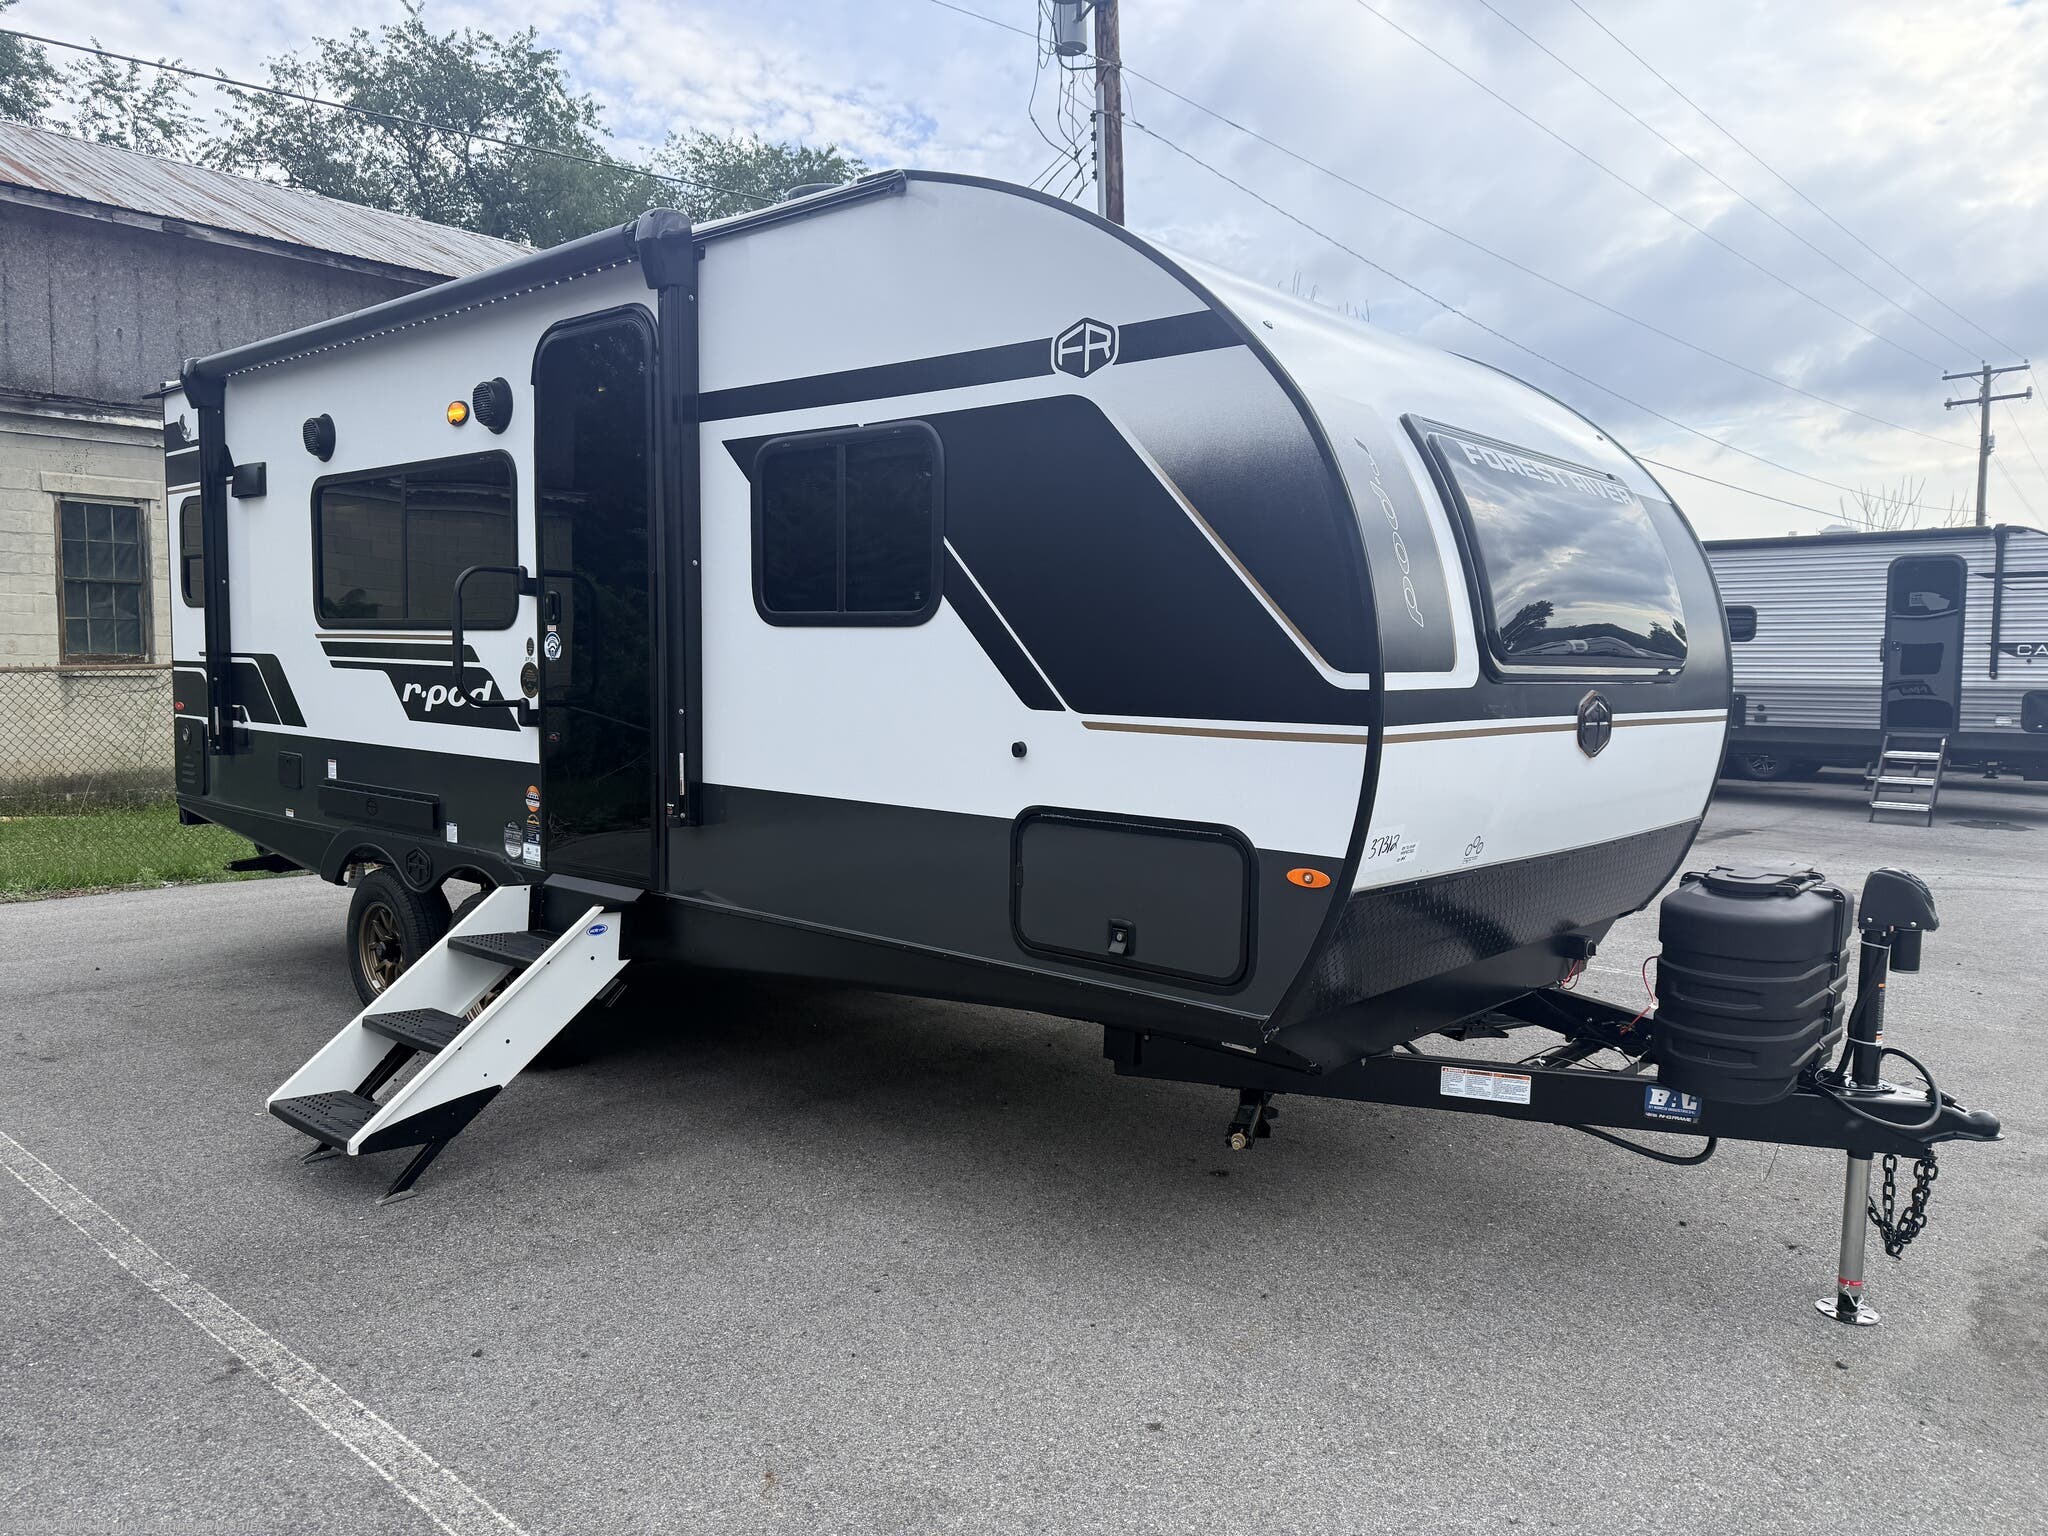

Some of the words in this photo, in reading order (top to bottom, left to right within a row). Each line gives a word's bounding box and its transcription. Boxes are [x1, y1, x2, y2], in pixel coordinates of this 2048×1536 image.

[1058, 323, 1111, 373] FR
[1457, 439, 1568, 487] FOREST
[1569, 472, 1637, 505] RIVER
